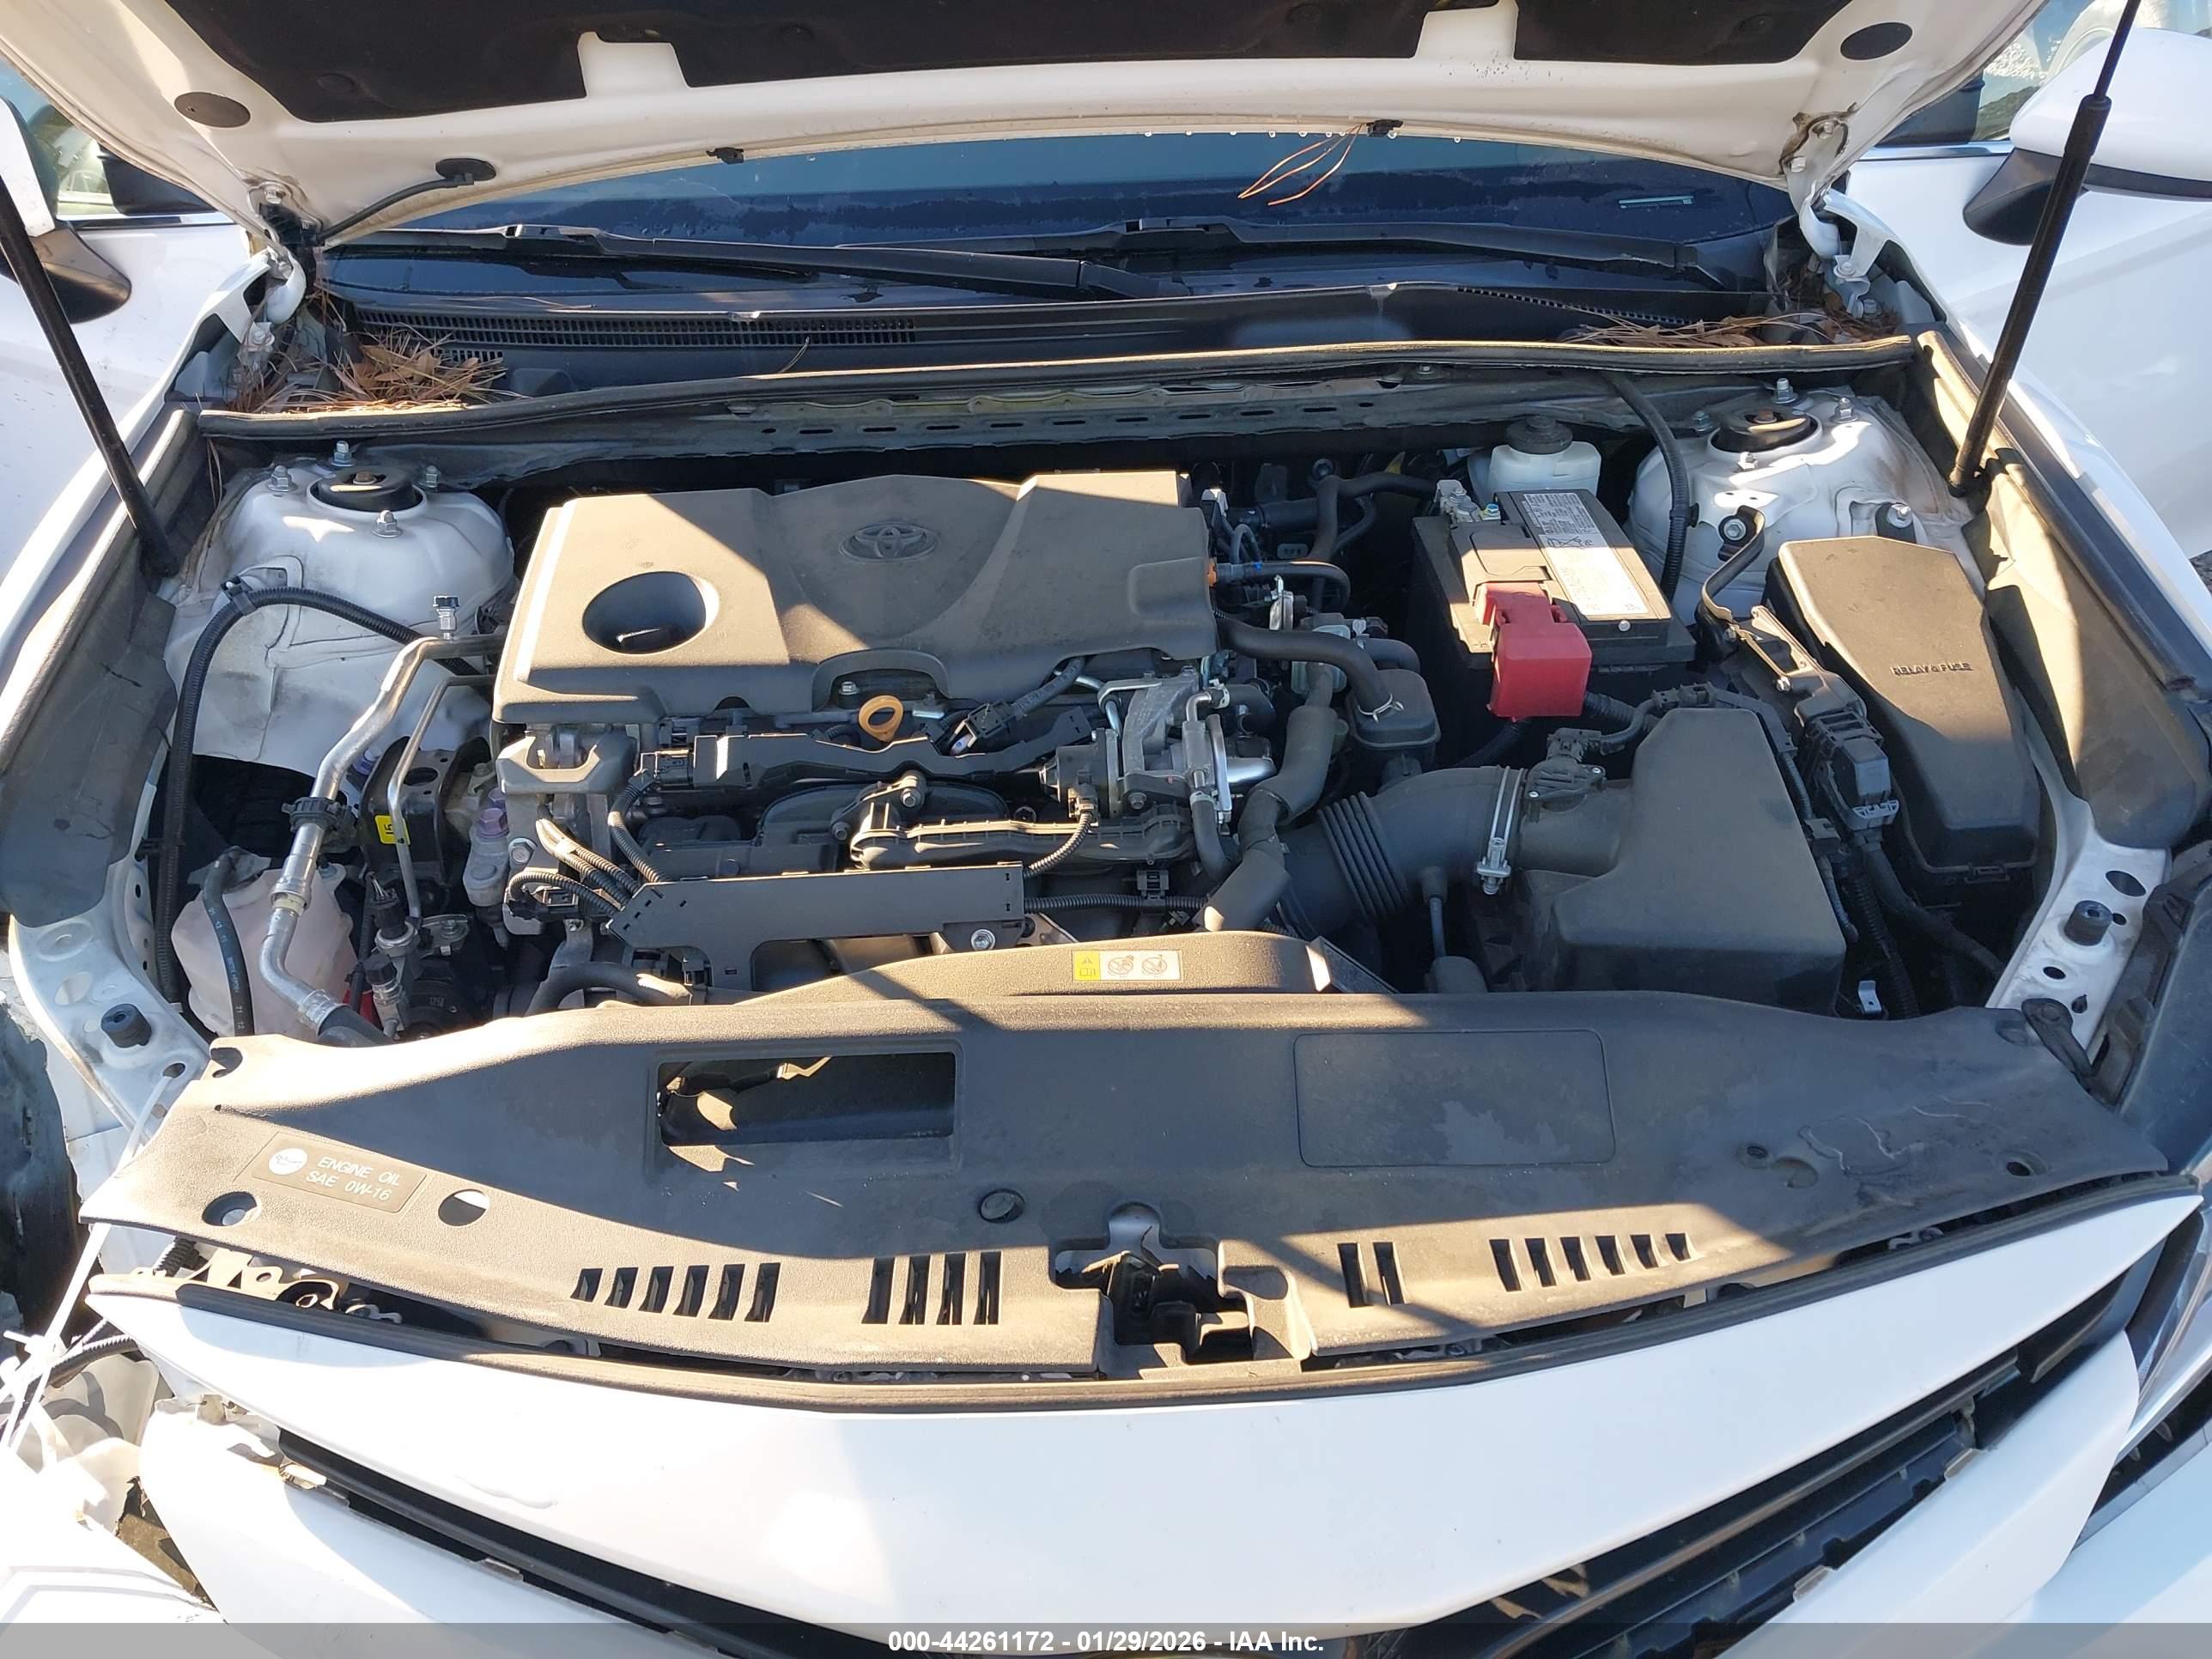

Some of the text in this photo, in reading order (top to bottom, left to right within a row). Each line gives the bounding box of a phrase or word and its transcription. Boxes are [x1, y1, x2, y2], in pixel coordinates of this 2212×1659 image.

[1889, 665, 1929, 677] RELAY
[1938, 661, 1973, 672] FUSE
[306, 1170, 392, 1200] SAE 0W-16
[318, 1156, 401, 1187] ENGINE OIL
